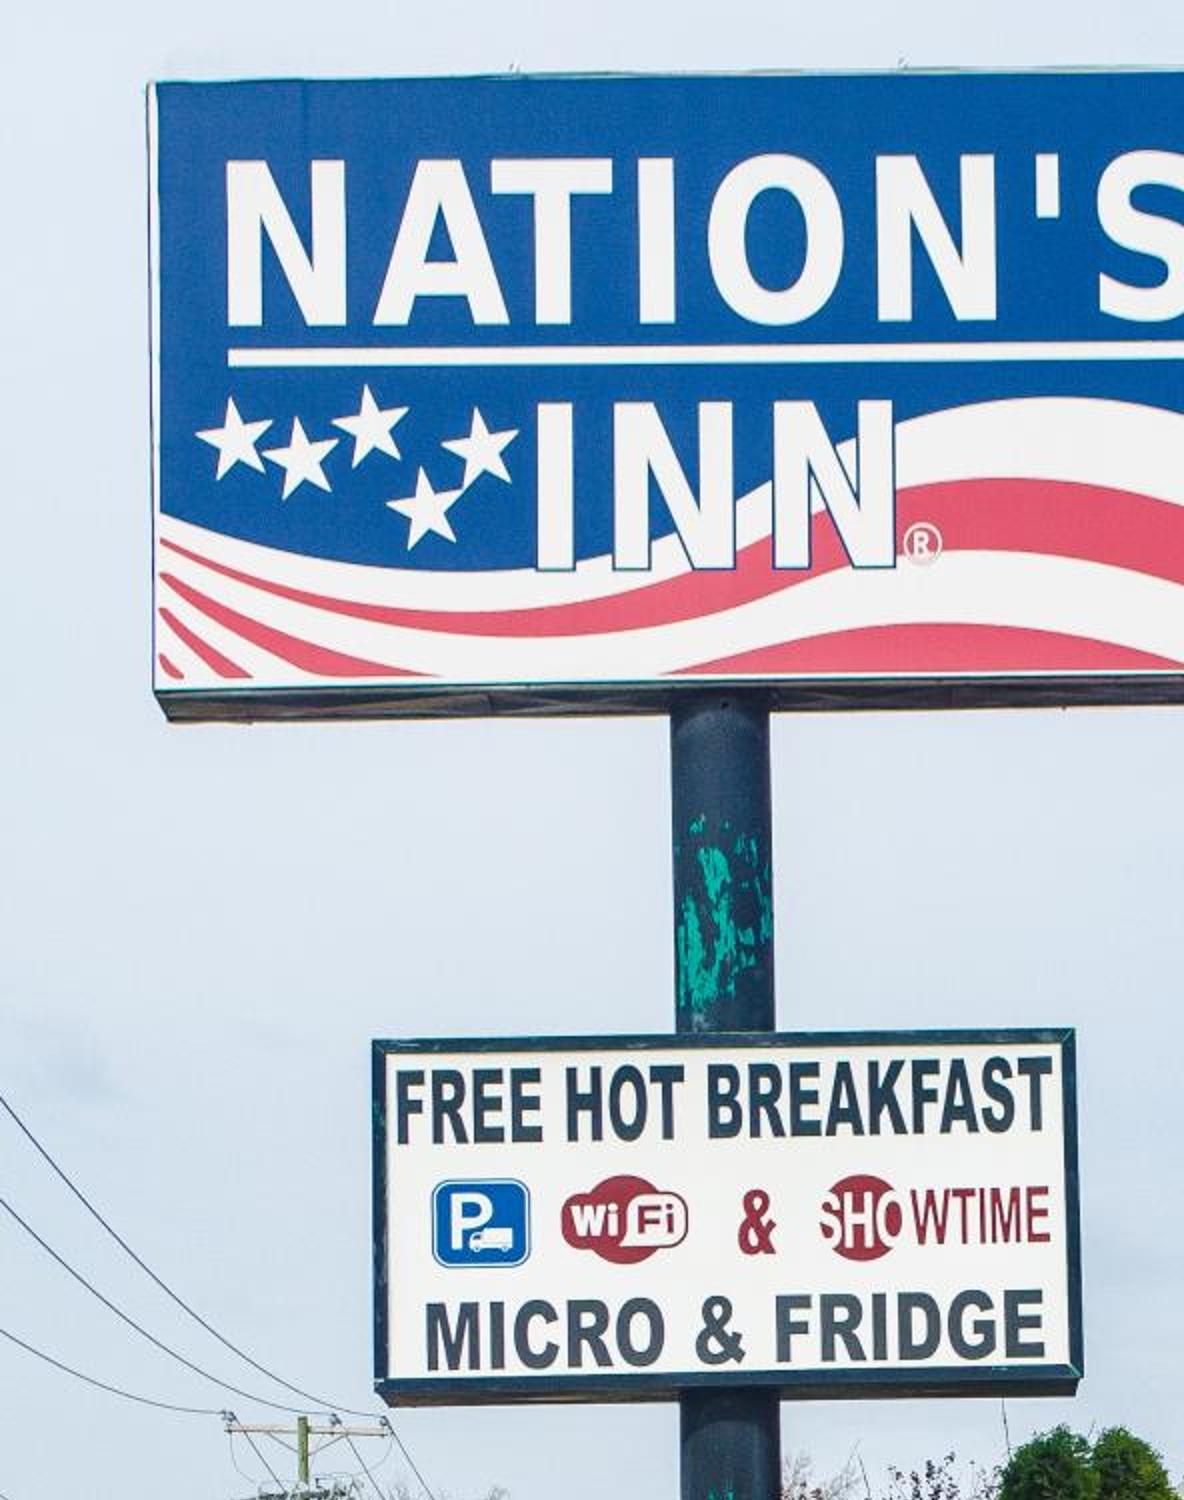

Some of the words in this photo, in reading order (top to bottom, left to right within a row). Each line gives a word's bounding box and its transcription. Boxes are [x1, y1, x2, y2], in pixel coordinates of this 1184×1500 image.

[535, 400, 896, 571] INN
[396, 1067, 543, 1144] FREE
[566, 1064, 685, 1142] HOT
[707, 1056, 1053, 1139] BREAKFAST
[737, 1189, 777, 1255] &
[820, 1186, 1051, 1249] SHOWTIME
[426, 1297, 665, 1371] MICRO
[696, 1295, 746, 1364] &
[775, 1289, 1046, 1362] FRIDGE
